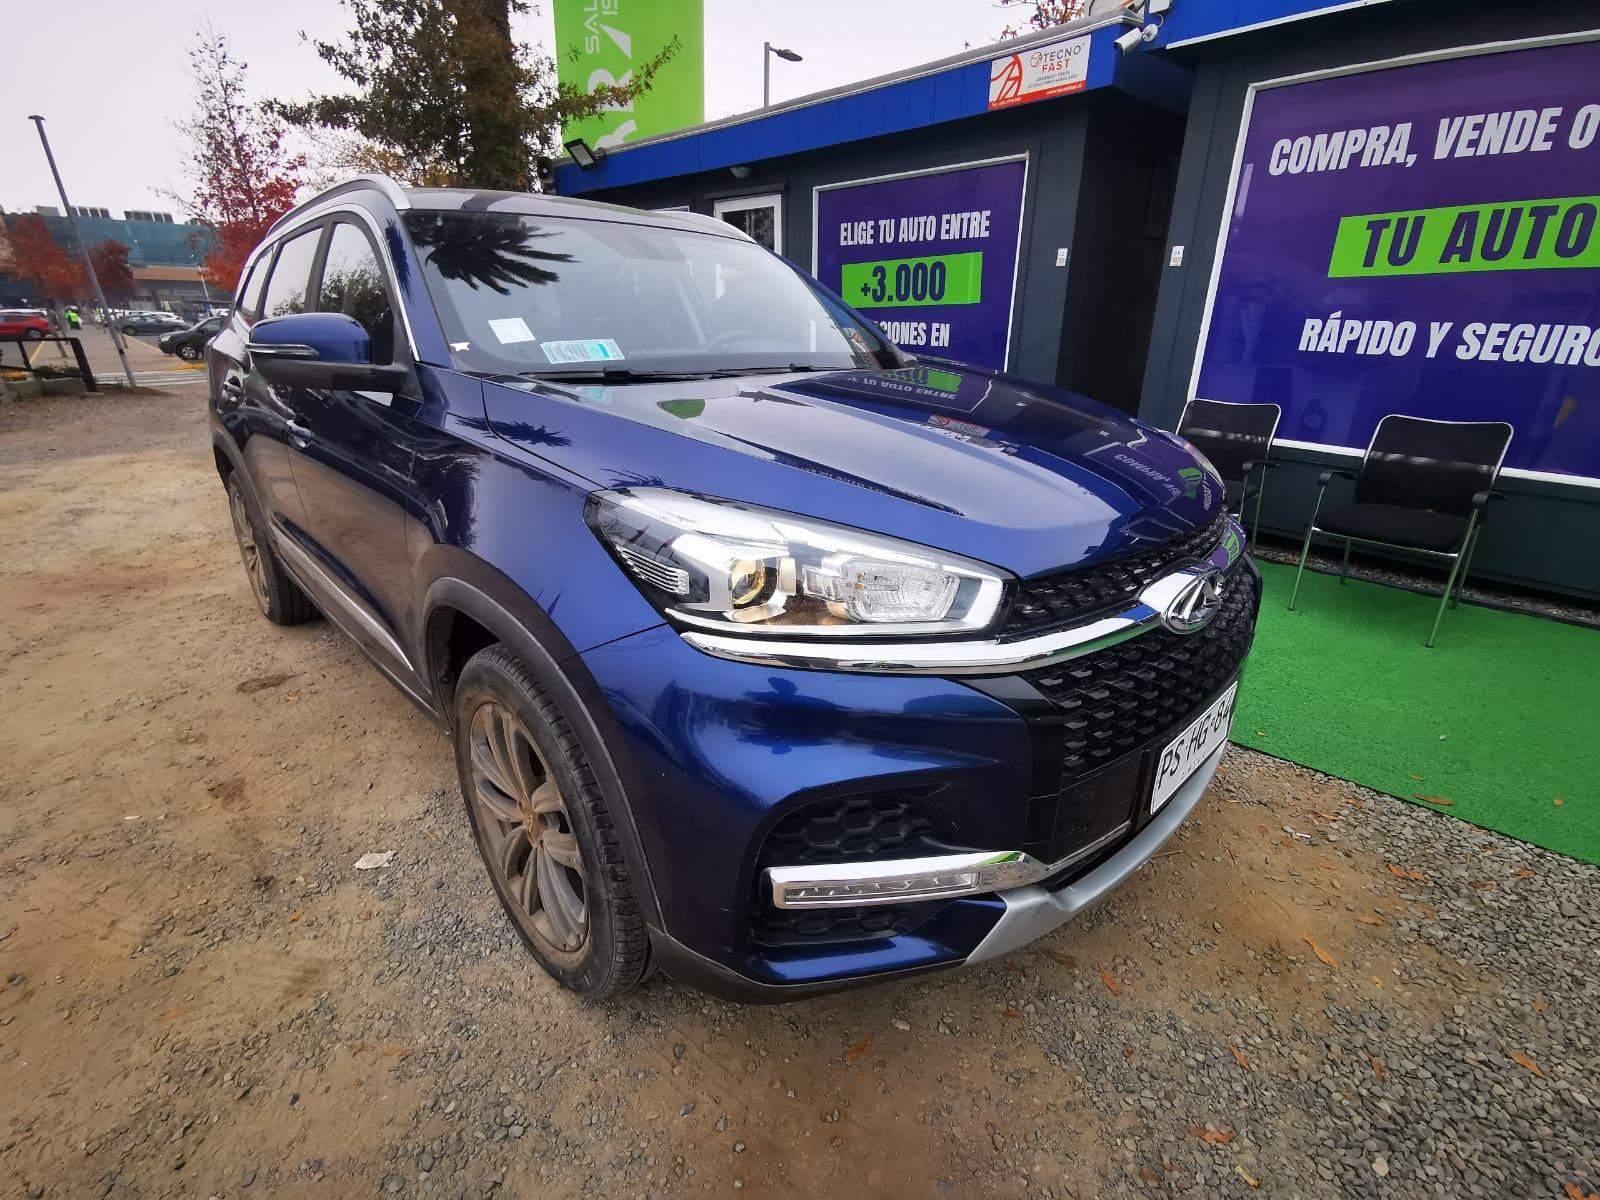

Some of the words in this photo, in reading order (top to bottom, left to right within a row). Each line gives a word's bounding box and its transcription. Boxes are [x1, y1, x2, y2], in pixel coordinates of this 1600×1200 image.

[1042, 59, 1071, 73] FAST
[1043, 45, 1082, 61] TECNO
[1268, 122, 1418, 176] COMPRA,
[1433, 106, 1563, 160] VENDE
[840, 220, 875, 246] ELIGE
[878, 218, 896, 244] TU
[898, 215, 937, 243] AUTO
[940, 210, 991, 240] ENTRE
[1362, 215, 1426, 268] TU
[1438, 202, 1598, 264] AUTO
[860, 261, 947, 303] +3.000
[930, 322, 951, 347] EN
[1298, 310, 1417, 357] RÁPIDO
[1425, 321, 1454, 358] Y
